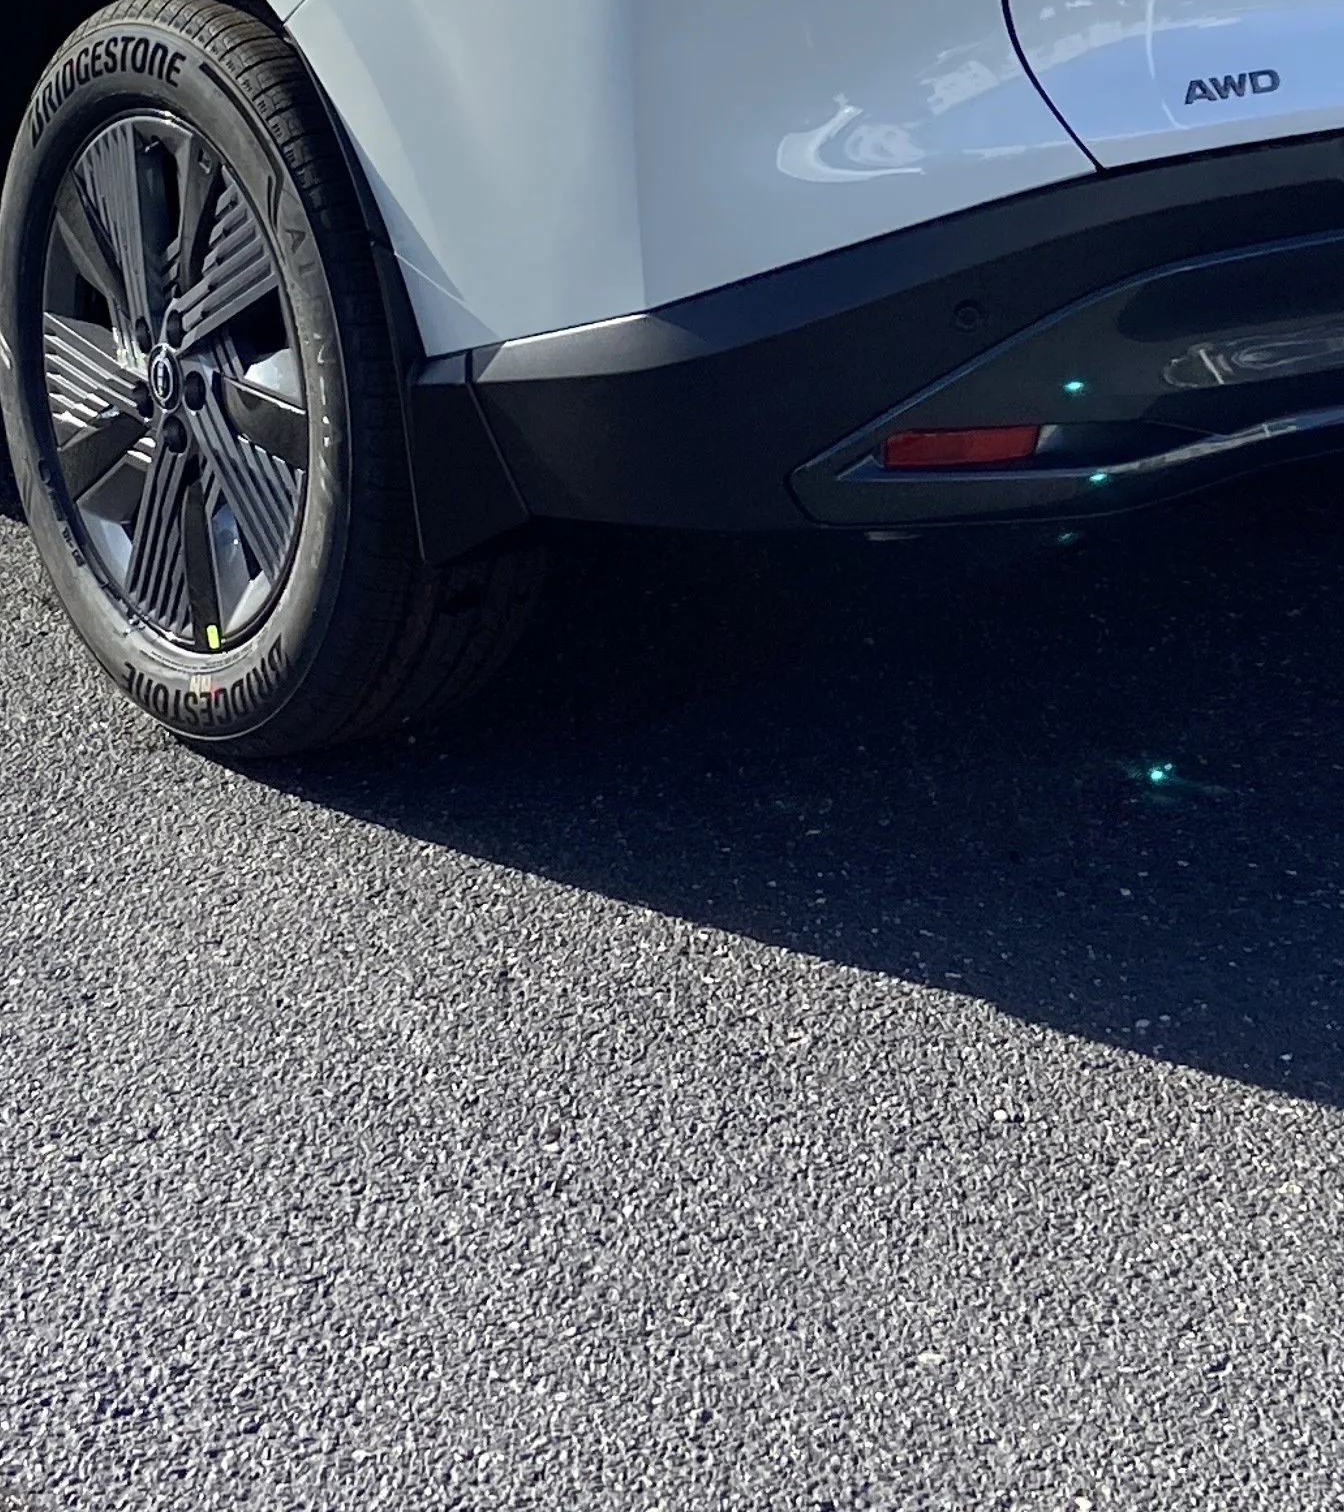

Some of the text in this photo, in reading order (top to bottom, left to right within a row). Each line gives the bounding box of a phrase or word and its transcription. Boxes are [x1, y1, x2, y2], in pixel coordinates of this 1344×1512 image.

[31, 35, 187, 149] BRIDGESTONE
[1184, 68, 1281, 105] AWD
[121, 632, 291, 730] BRIDGESTONE
